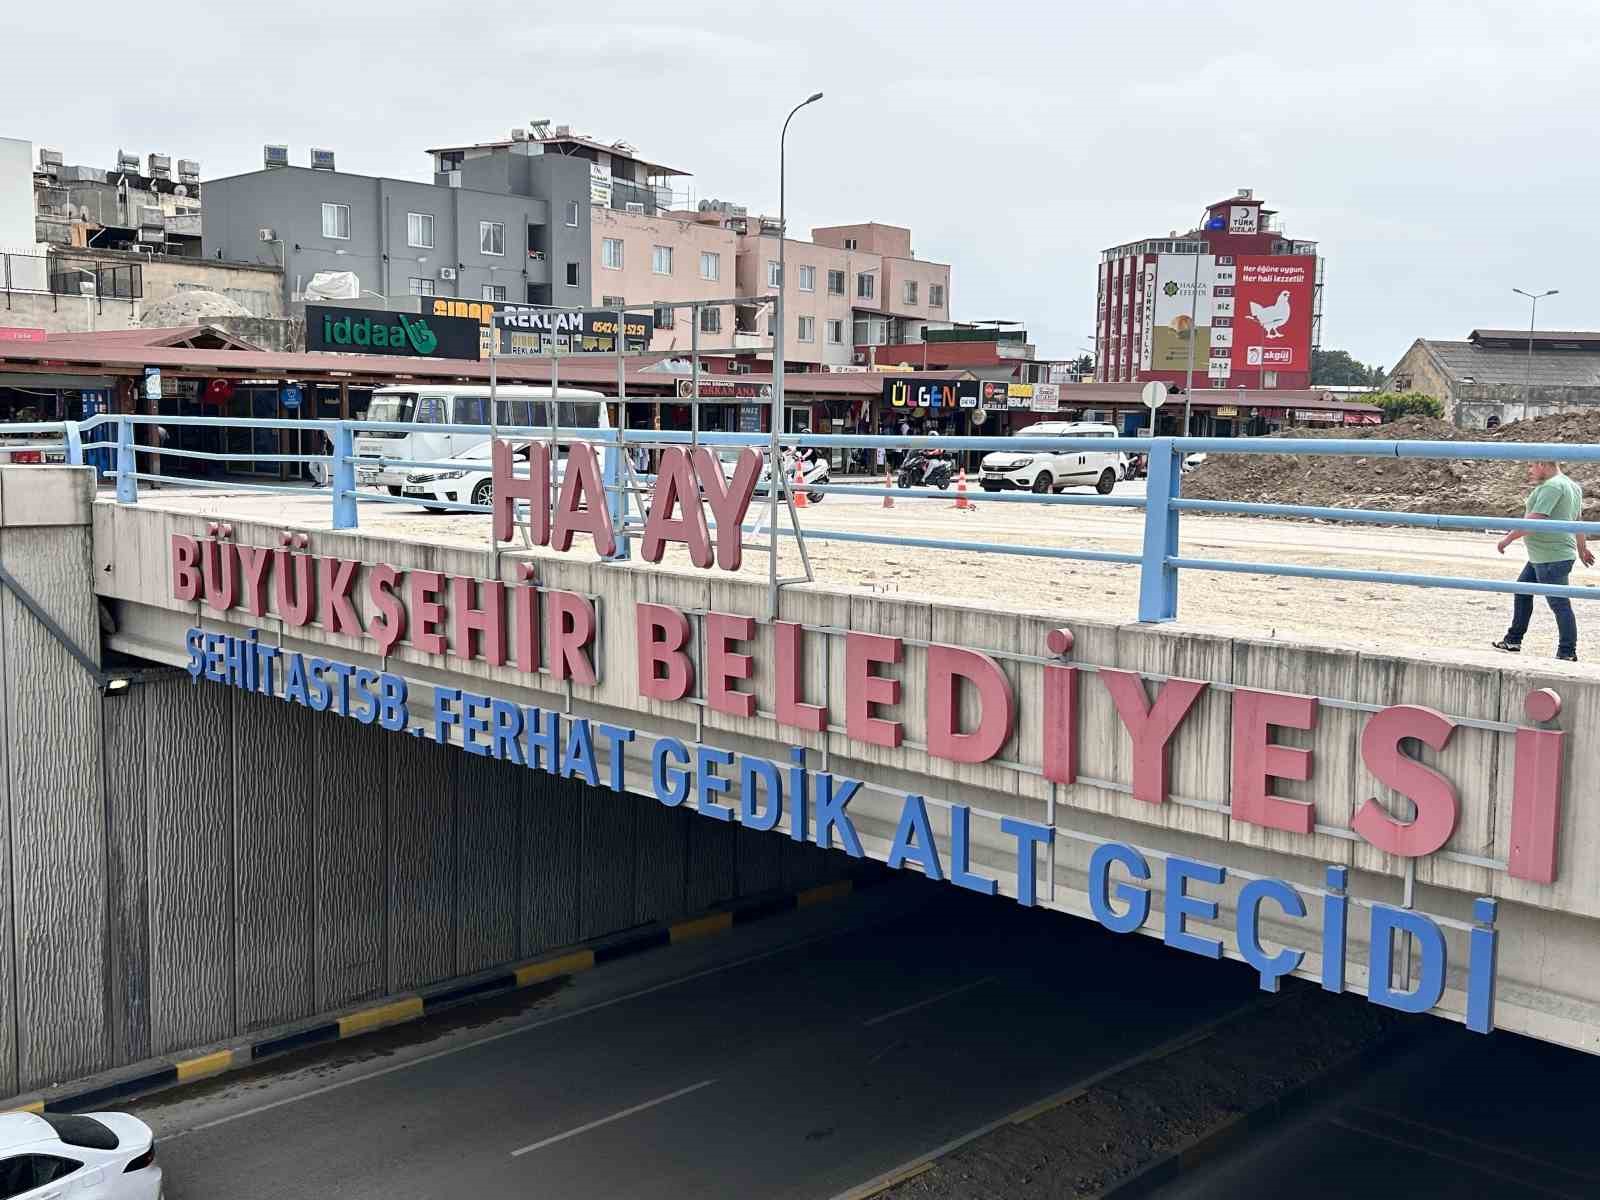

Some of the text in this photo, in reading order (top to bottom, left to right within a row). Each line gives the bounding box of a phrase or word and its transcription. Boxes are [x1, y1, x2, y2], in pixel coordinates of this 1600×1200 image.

[1243, 274, 1256, 282] Her
[323, 314, 406, 347] iddaa
[503, 305, 584, 331] REKLAM
[892, 381, 956, 407] ÜLGEN
[171, 522, 1566, 884] BÜYÜKŞEHİR BELEDİYESİ
[184, 627, 280, 696] ŞEHİT
[434, 686, 635, 792] FERHAT
[651, 736, 864, 858] GEDİK
[887, 794, 1055, 907] ALT
[1088, 842, 1498, 1034] GEÇİDİ
